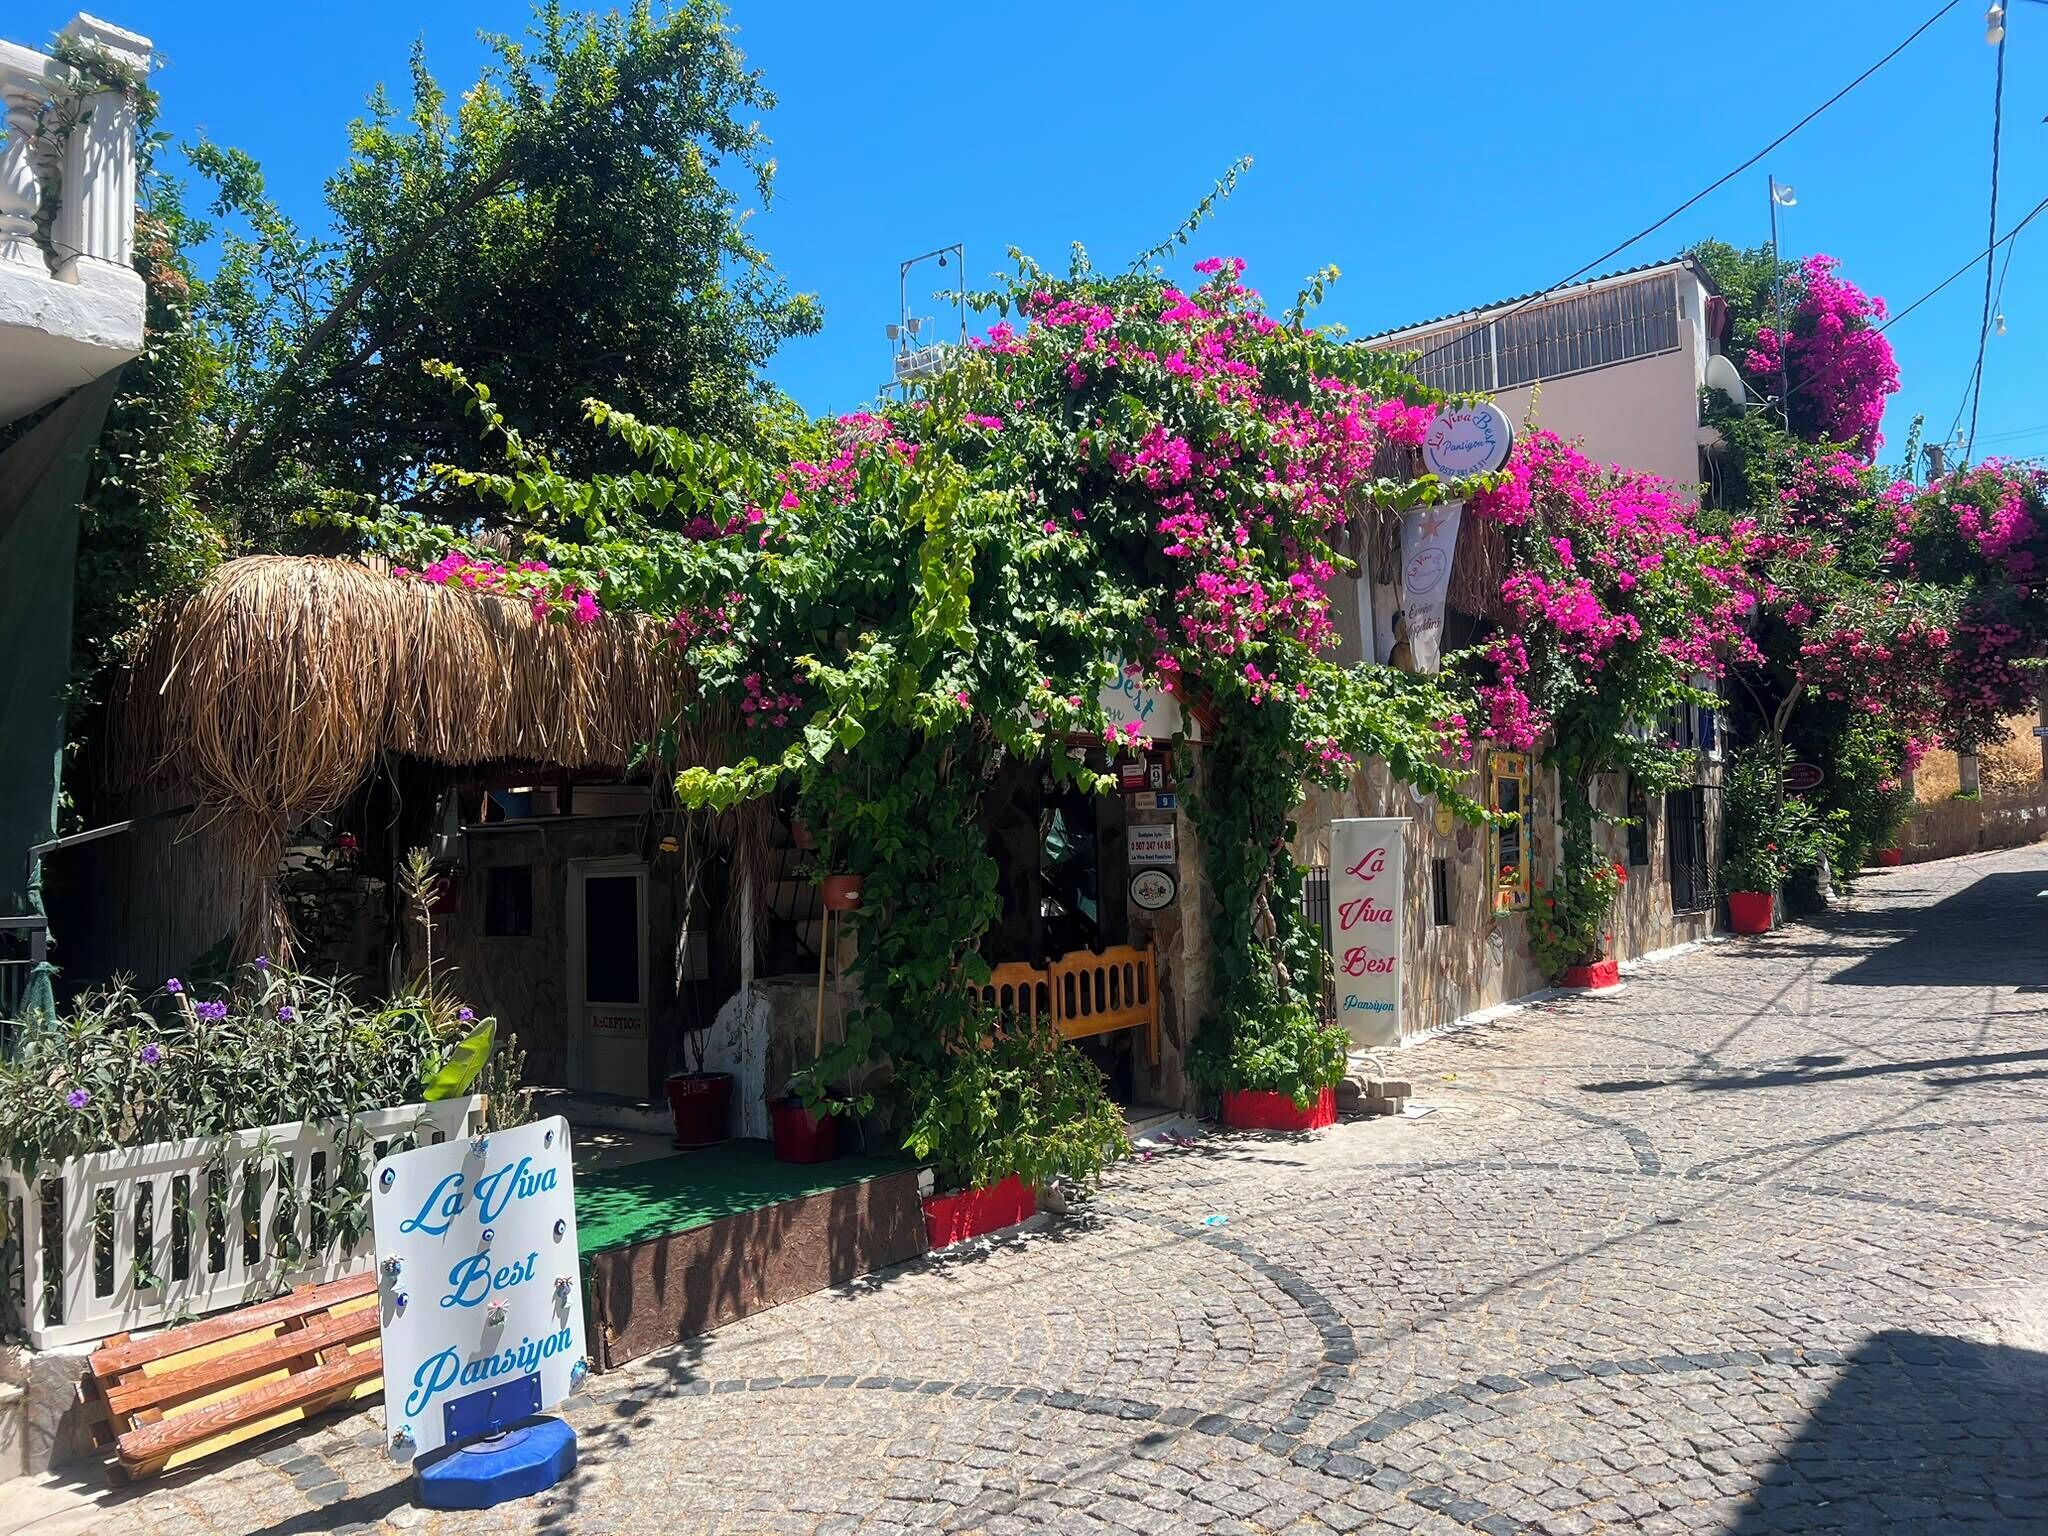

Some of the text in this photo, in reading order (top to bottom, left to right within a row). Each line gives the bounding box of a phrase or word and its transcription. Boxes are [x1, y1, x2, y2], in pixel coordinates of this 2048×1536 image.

[1428, 411, 1496, 449] La Viva Best
[1443, 440, 1485, 456] Pansiyon
[1152, 770, 1160, 782] 9
[1162, 797, 1168, 806] 9
[1345, 847, 1385, 881] La
[1338, 898, 1393, 931] Viva
[1339, 945, 1396, 977] Best
[1344, 994, 1394, 1014] Pansiyon
[593, 1016, 641, 1030] RECEPTION
[400, 1156, 558, 1236] La Viva
[440, 1248, 540, 1308] Best
[405, 1326, 572, 1417] Pansiyon
